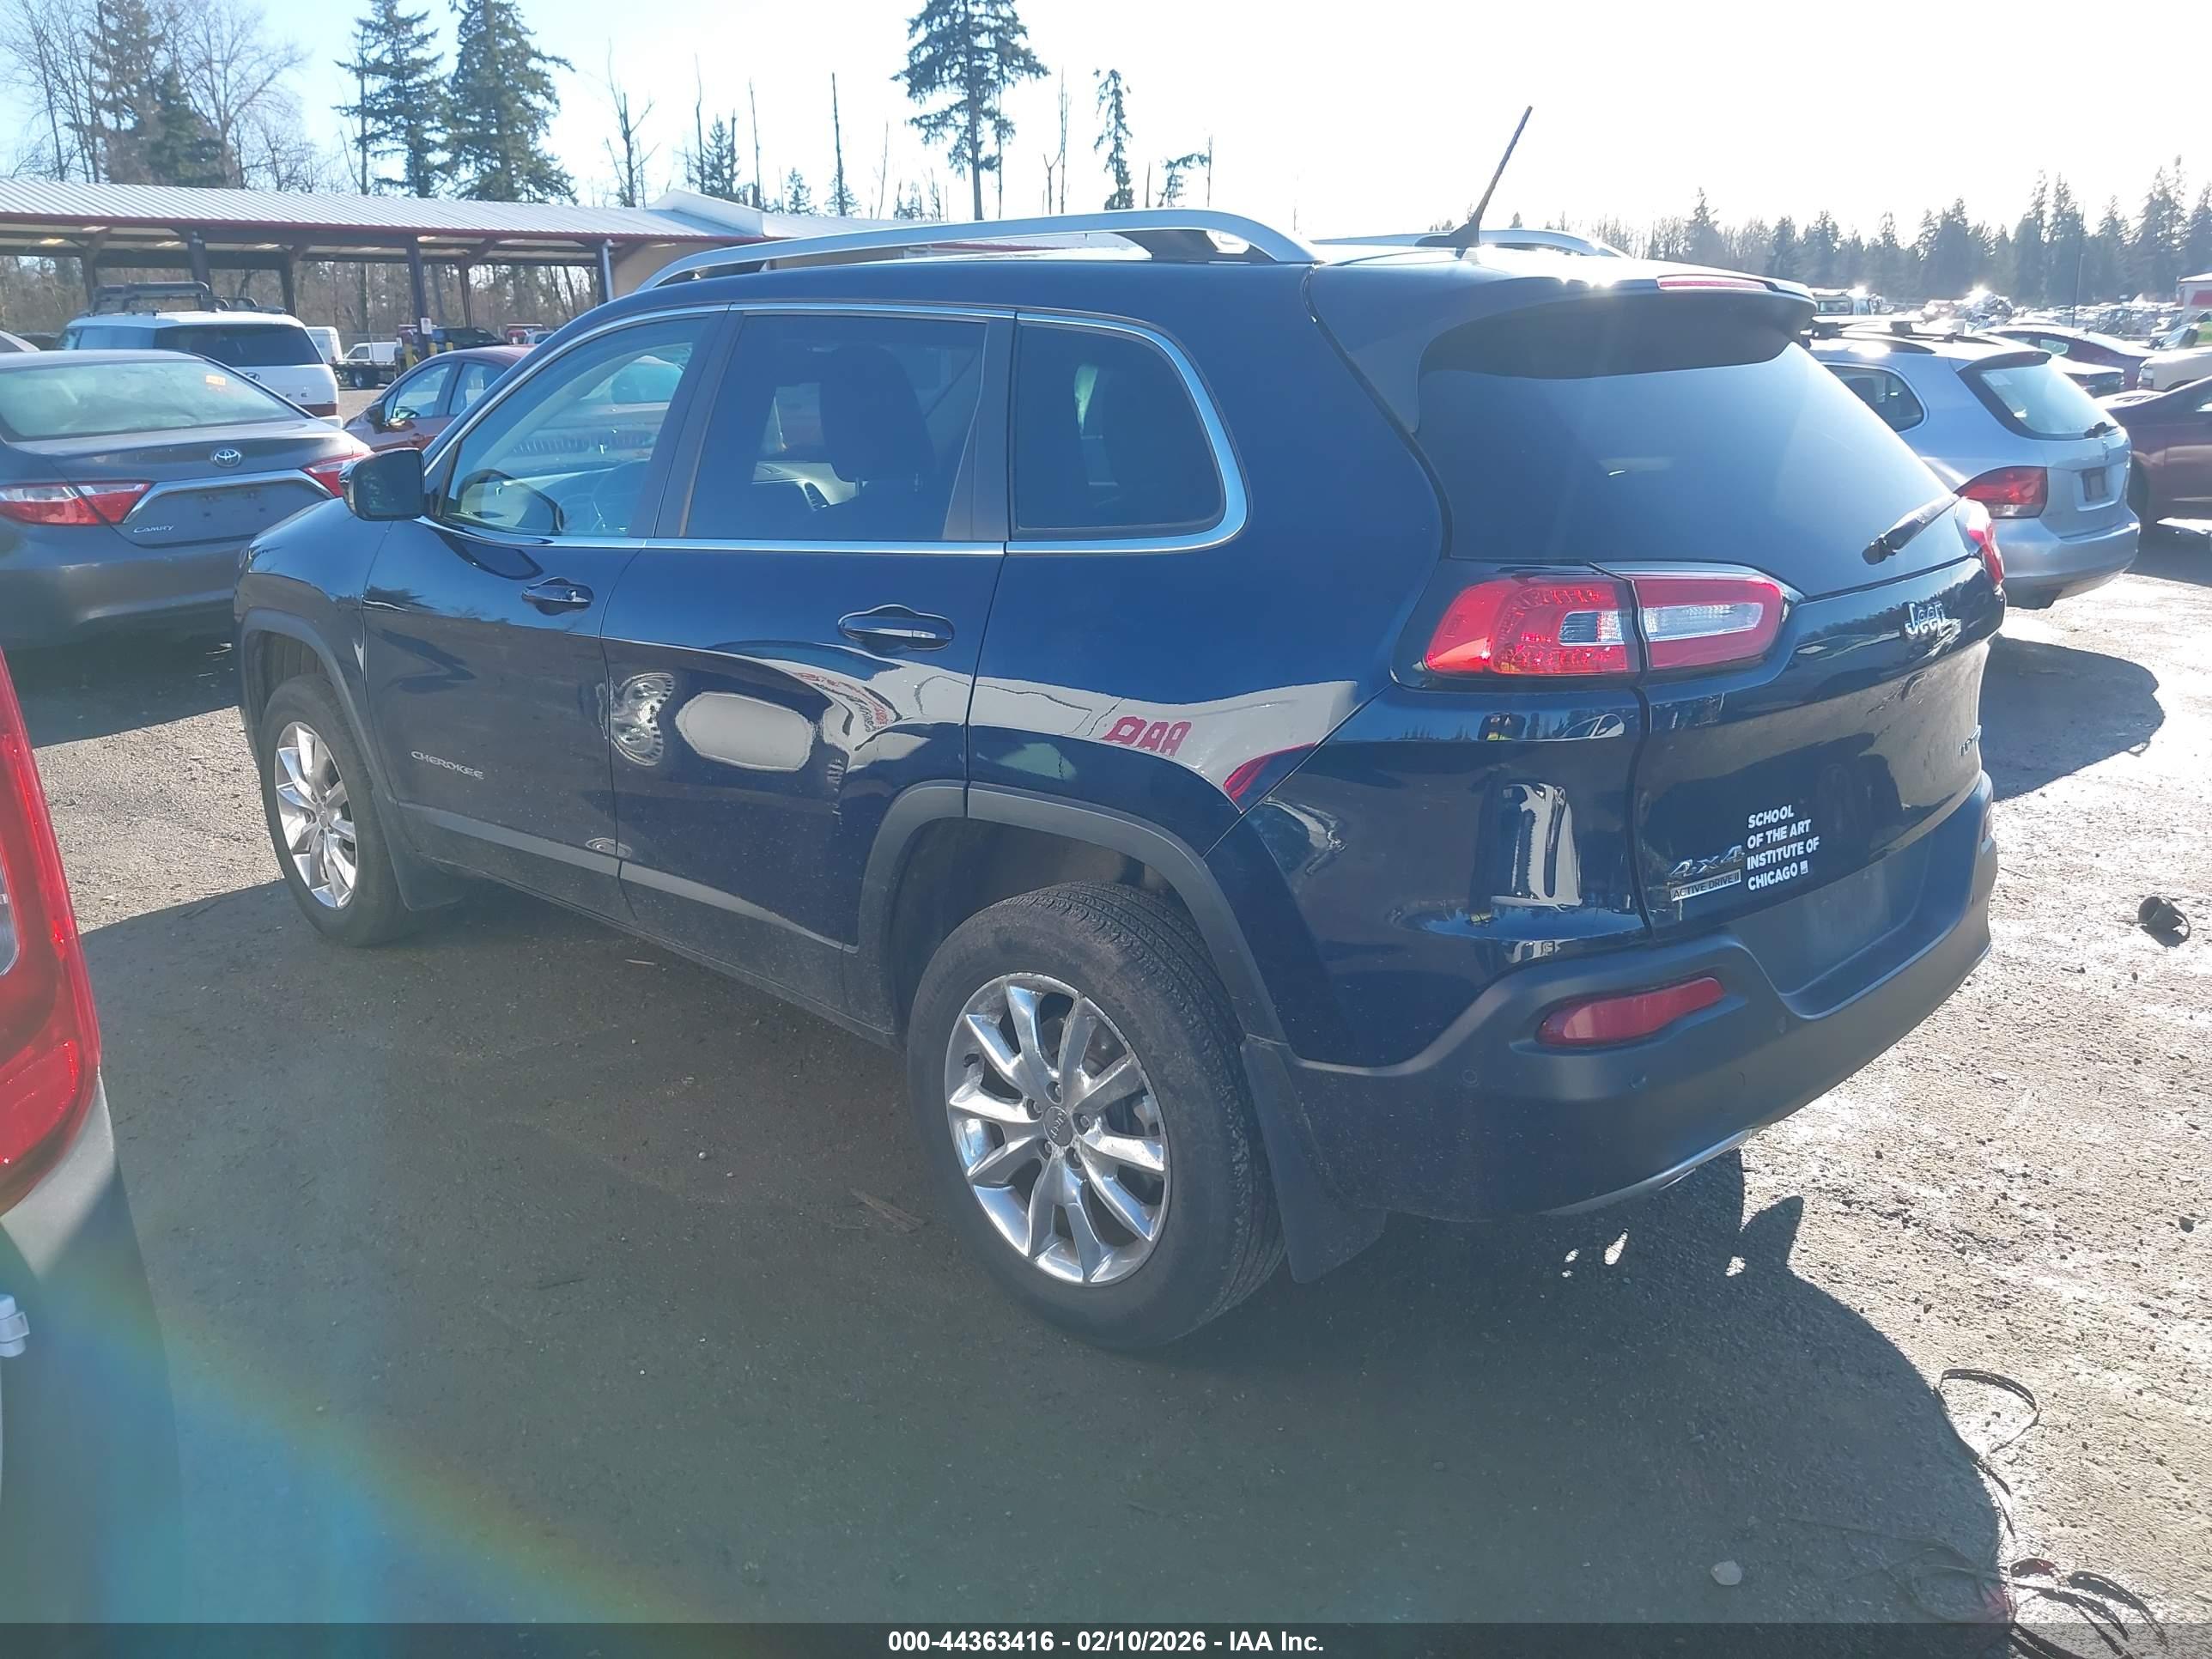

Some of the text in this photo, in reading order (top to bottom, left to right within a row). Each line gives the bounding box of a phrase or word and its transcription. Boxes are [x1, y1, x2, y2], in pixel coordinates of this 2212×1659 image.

[410, 750, 484, 781] CHEROKEE
[1748, 805, 1795, 829] SCHOOL
[1747, 818, 1812, 849] OF THE ART
[1747, 836, 1820, 871] INSTITUTE OF
[1673, 884, 1707, 899] ACTIVE
[1709, 876, 1732, 889] DRIVE
[1747, 862, 1798, 891] CHICAGO
